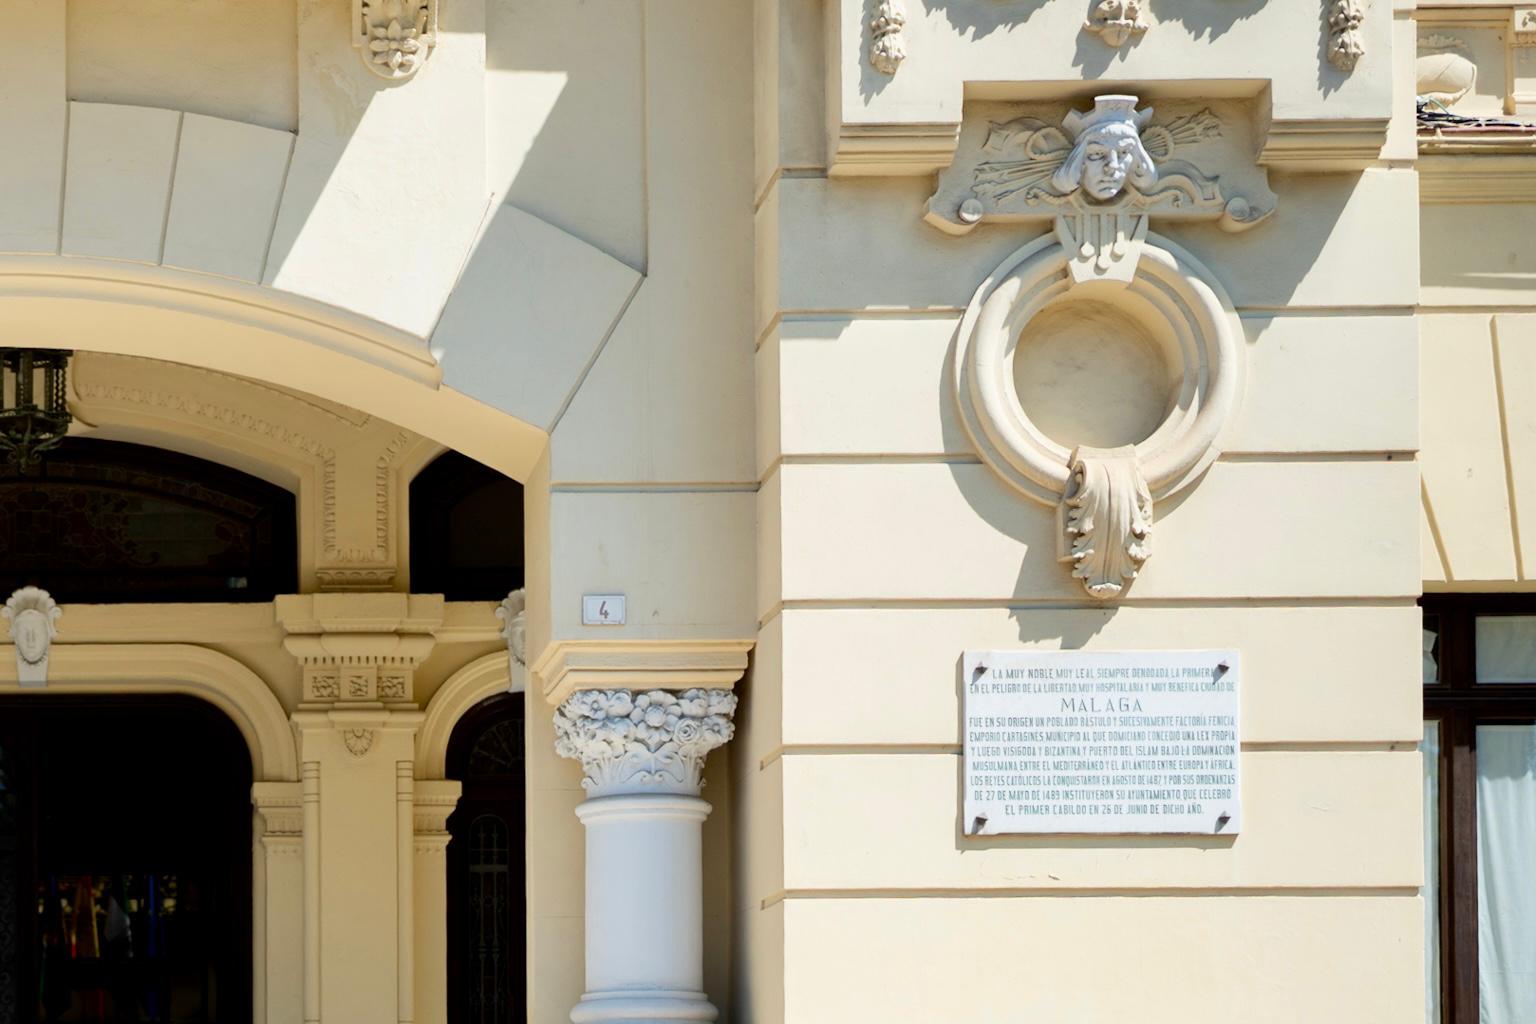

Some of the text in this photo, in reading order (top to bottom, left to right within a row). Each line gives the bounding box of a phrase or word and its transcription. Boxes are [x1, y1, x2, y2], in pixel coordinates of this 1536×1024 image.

[599, 601, 609, 619] 4
[992, 669, 1003, 679] LA
[1006, 669, 1024, 679] MUY
[1056, 668, 1072, 679] MUY
[1097, 668, 1129, 679] SIEMPRE
[1171, 668, 1179, 679] LA
[970, 684, 979, 694] EN
[981, 684, 989, 694] EL
[992, 684, 1021, 694] PELIGRO
[1023, 684, 1032, 694] DE
[1034, 684, 1041, 694] LA
[1079, 683, 1094, 694] MUY
[1151, 683, 1166, 693] MUY
[1226, 682, 1235, 693] DE
[1061, 694, 1143, 712] MÁLAGA
[969, 717, 982, 727] FUE
[985, 717, 994, 727] EN
[996, 717, 1006, 727] SU
[1008, 717, 1033, 727] ORIGEN
[1035, 717, 1045, 727] UN
[1046, 717, 1078, 727] POBLADO
[1119, 716, 1173, 726] SUCESIVAMENTE
[970, 732, 1000, 742] EMPORIO
[1045, 732, 1080, 742] MUNICIPIO
[1083, 732, 1091, 742] AL
[1093, 732, 1106, 742] QUE
[1108, 731, 1146, 742] DOMICIANO
[1182, 731, 1196, 742] UNA
[1197, 731, 1209, 742] LEX
[978, 747, 1001, 757] LUEGO
[1003, 747, 1036, 757] VISIGODA
[1045, 747, 1080, 757] BIZANTINA
[1089, 747, 1118, 757] PUERTO
[1120, 746, 1133, 757] DEL
[1135, 746, 1159, 757] ISLAM
[1161, 746, 1180, 757] BAJO
[1181, 746, 1190, 757] LA
[1020, 761, 1041, 771] ENTRE
[1043, 761, 1051, 771] EL
[1111, 760, 1120, 771] EL
[1157, 760, 1177, 771] ENTRE
[1179, 760, 1204, 771] EUROPA
[970, 776, 983, 786] LOS
[984, 776, 1005, 786] REYES
[1043, 776, 1051, 786] LA
[1101, 776, 1110, 785] EN
[1112, 775, 1137, 785] AGOSTO
[1138, 775, 1145, 785] DE
[1169, 775, 1181, 785] POR
[1182, 775, 1195, 785] SUS
[974, 791, 983, 801] DE
[986, 791, 995, 801] 27
[997, 791, 1006, 801] DE
[1009, 791, 1029, 801] MAYO
[1032, 791, 1040, 801] DE
[1042, 791, 1060, 801] 1489
[1062, 790, 1114, 801] INSTITUYERON
[1115, 790, 1125, 800] SU
[1183, 790, 1197, 800] QUE
[1005, 806, 1015, 815] EL
[1018, 805, 1050, 815] PRIMER
[1053, 805, 1087, 815] CABILDO
[1089, 805, 1099, 815] EN
[1102, 805, 1112, 815] 26
[1114, 805, 1122, 815] DE
[1127, 805, 1148, 815] JUNIO
[1150, 805, 1159, 815] DE
[1163, 805, 1185, 815] DICHO
